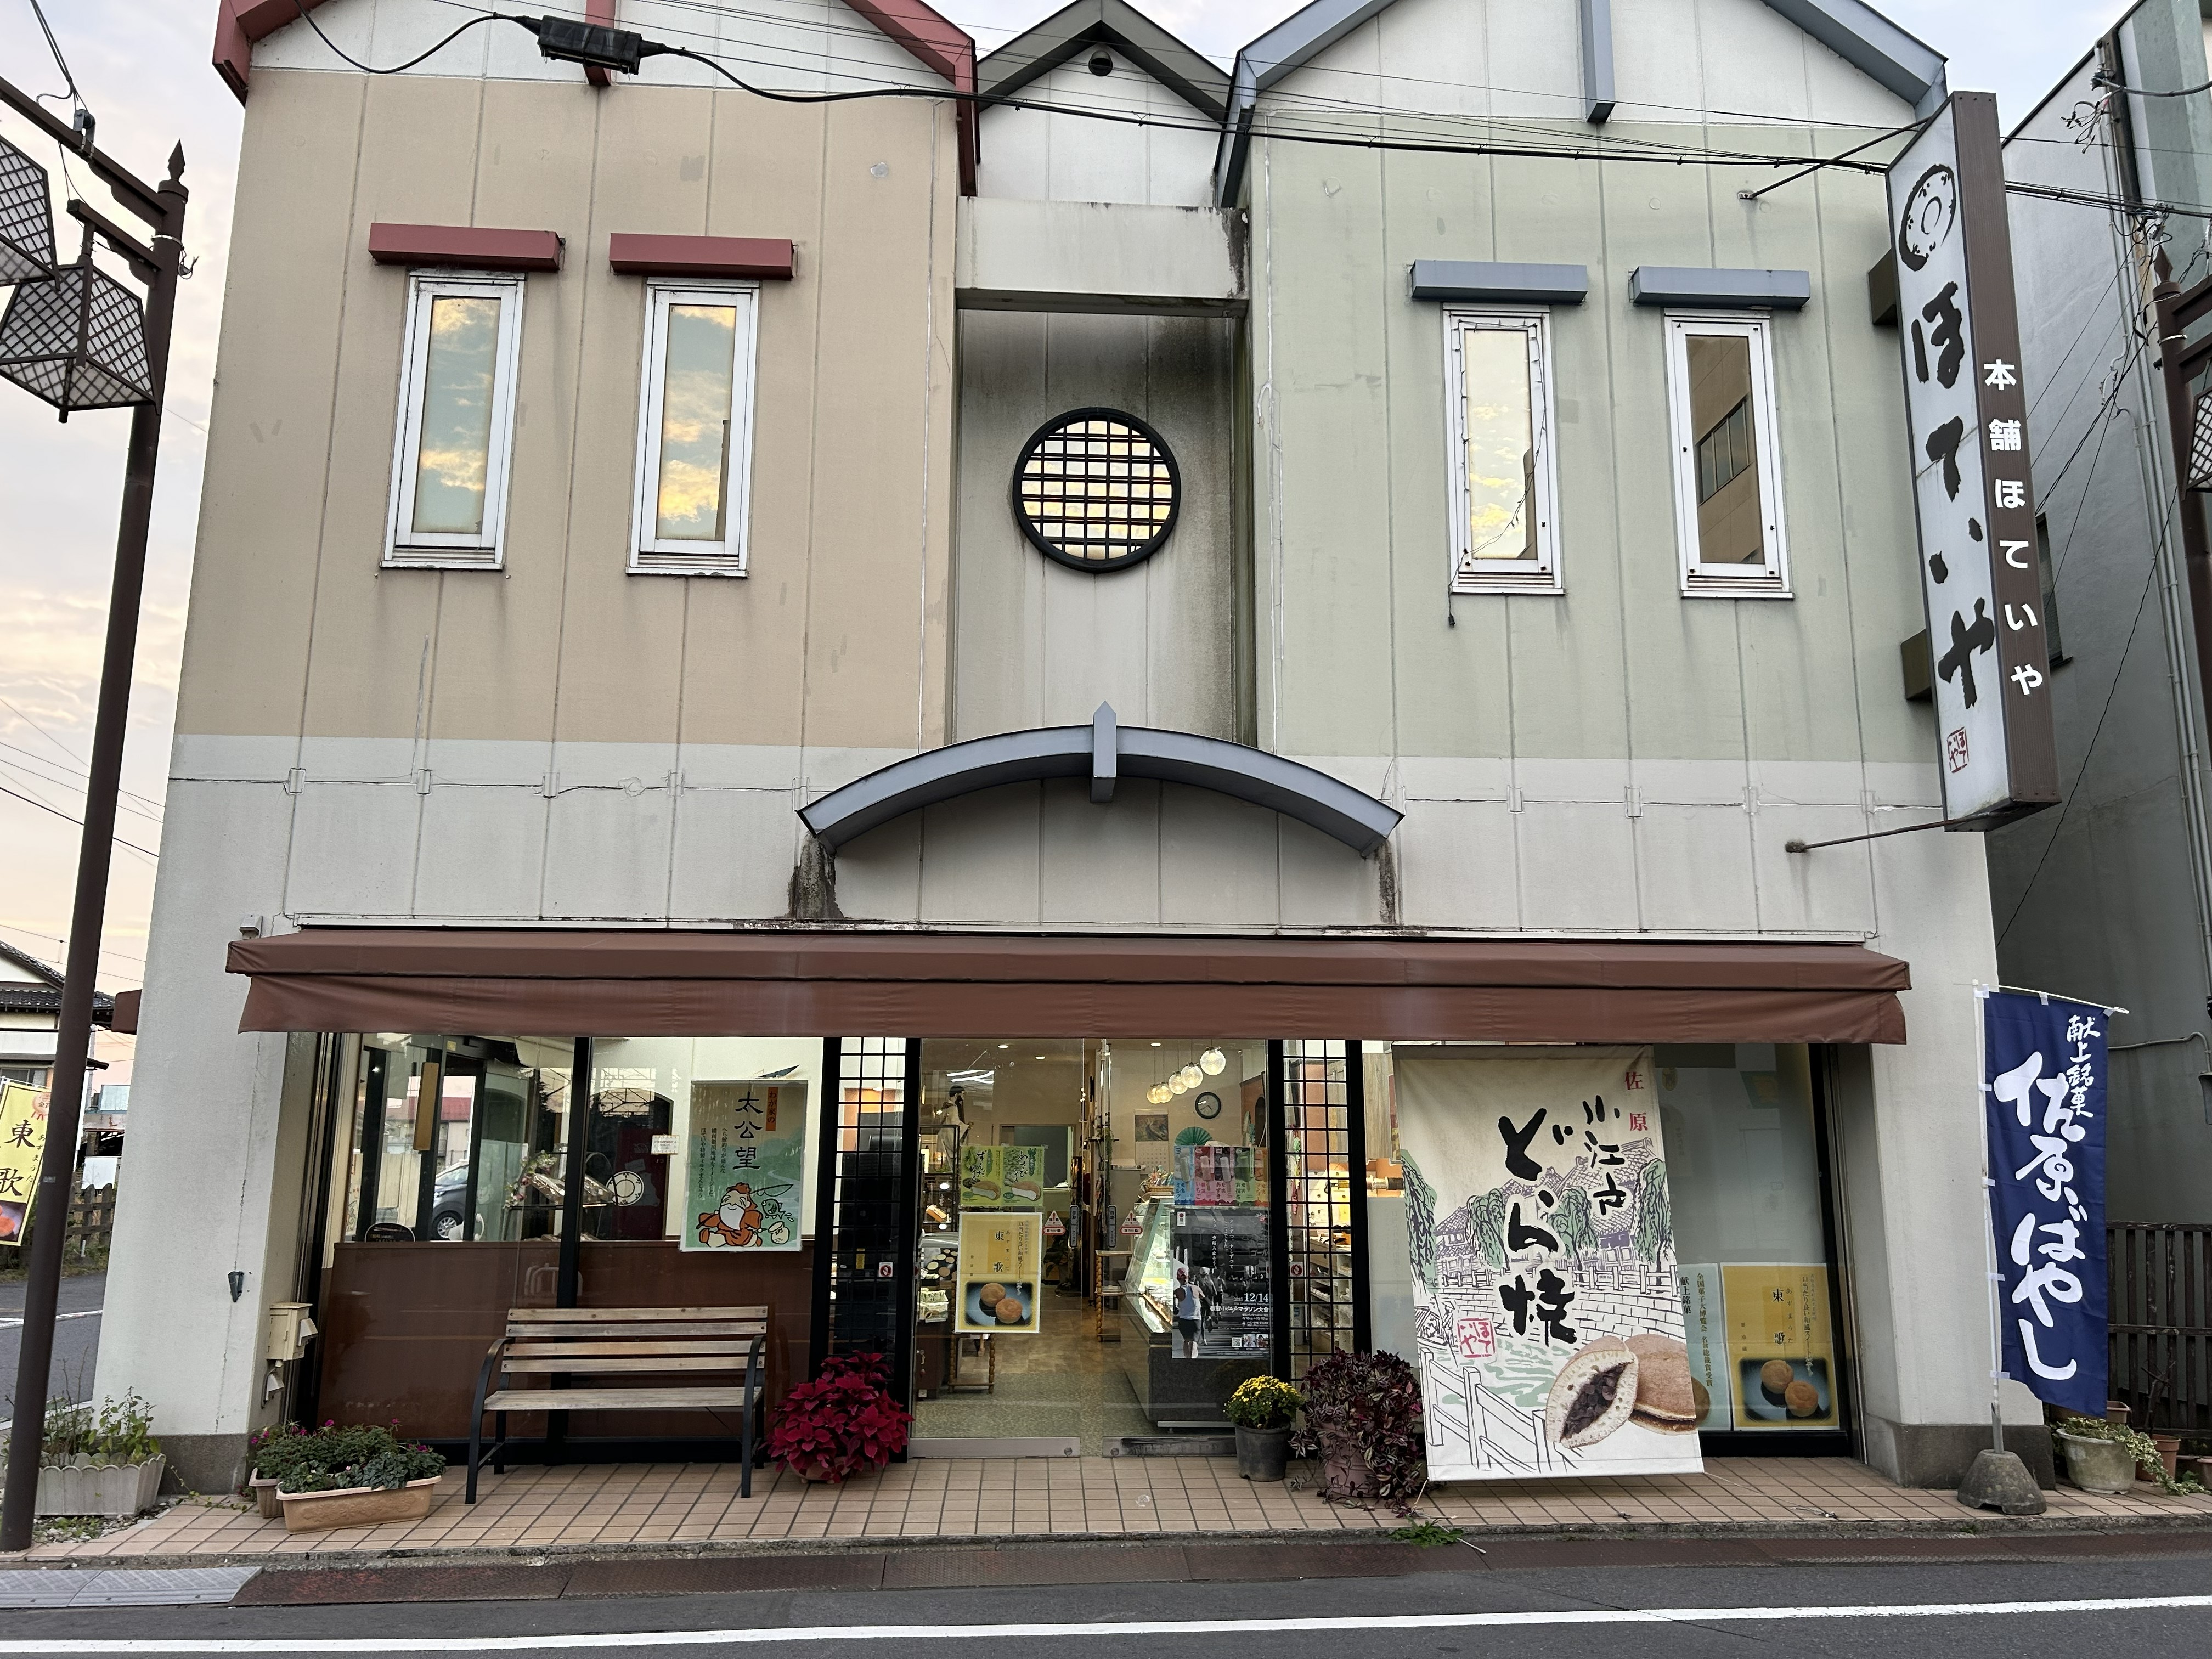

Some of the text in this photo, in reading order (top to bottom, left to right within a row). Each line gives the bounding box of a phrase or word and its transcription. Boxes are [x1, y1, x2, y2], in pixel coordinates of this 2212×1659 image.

[1912, 280, 1995, 708] ほていや
[1983, 359, 2044, 696] 本舗ほていや
[2067, 1015, 2101, 1117] 献上銘菓
[733, 1091, 763, 1170] 太公望
[767, 1091, 777, 1124] わが家の
[1624, 1071, 1648, 1132] 佐原
[1019, 1151, 1028, 1177] わさび
[1993, 1051, 2089, 1380] 佐原ばやし
[994, 1231, 1005, 1272] 東歌
[1244, 1293, 1269, 1302] 12/14
[1680, 1277, 1691, 1314] 献上銘菓
[1697, 1273, 1707, 1332] 全国菓子大博覧会
